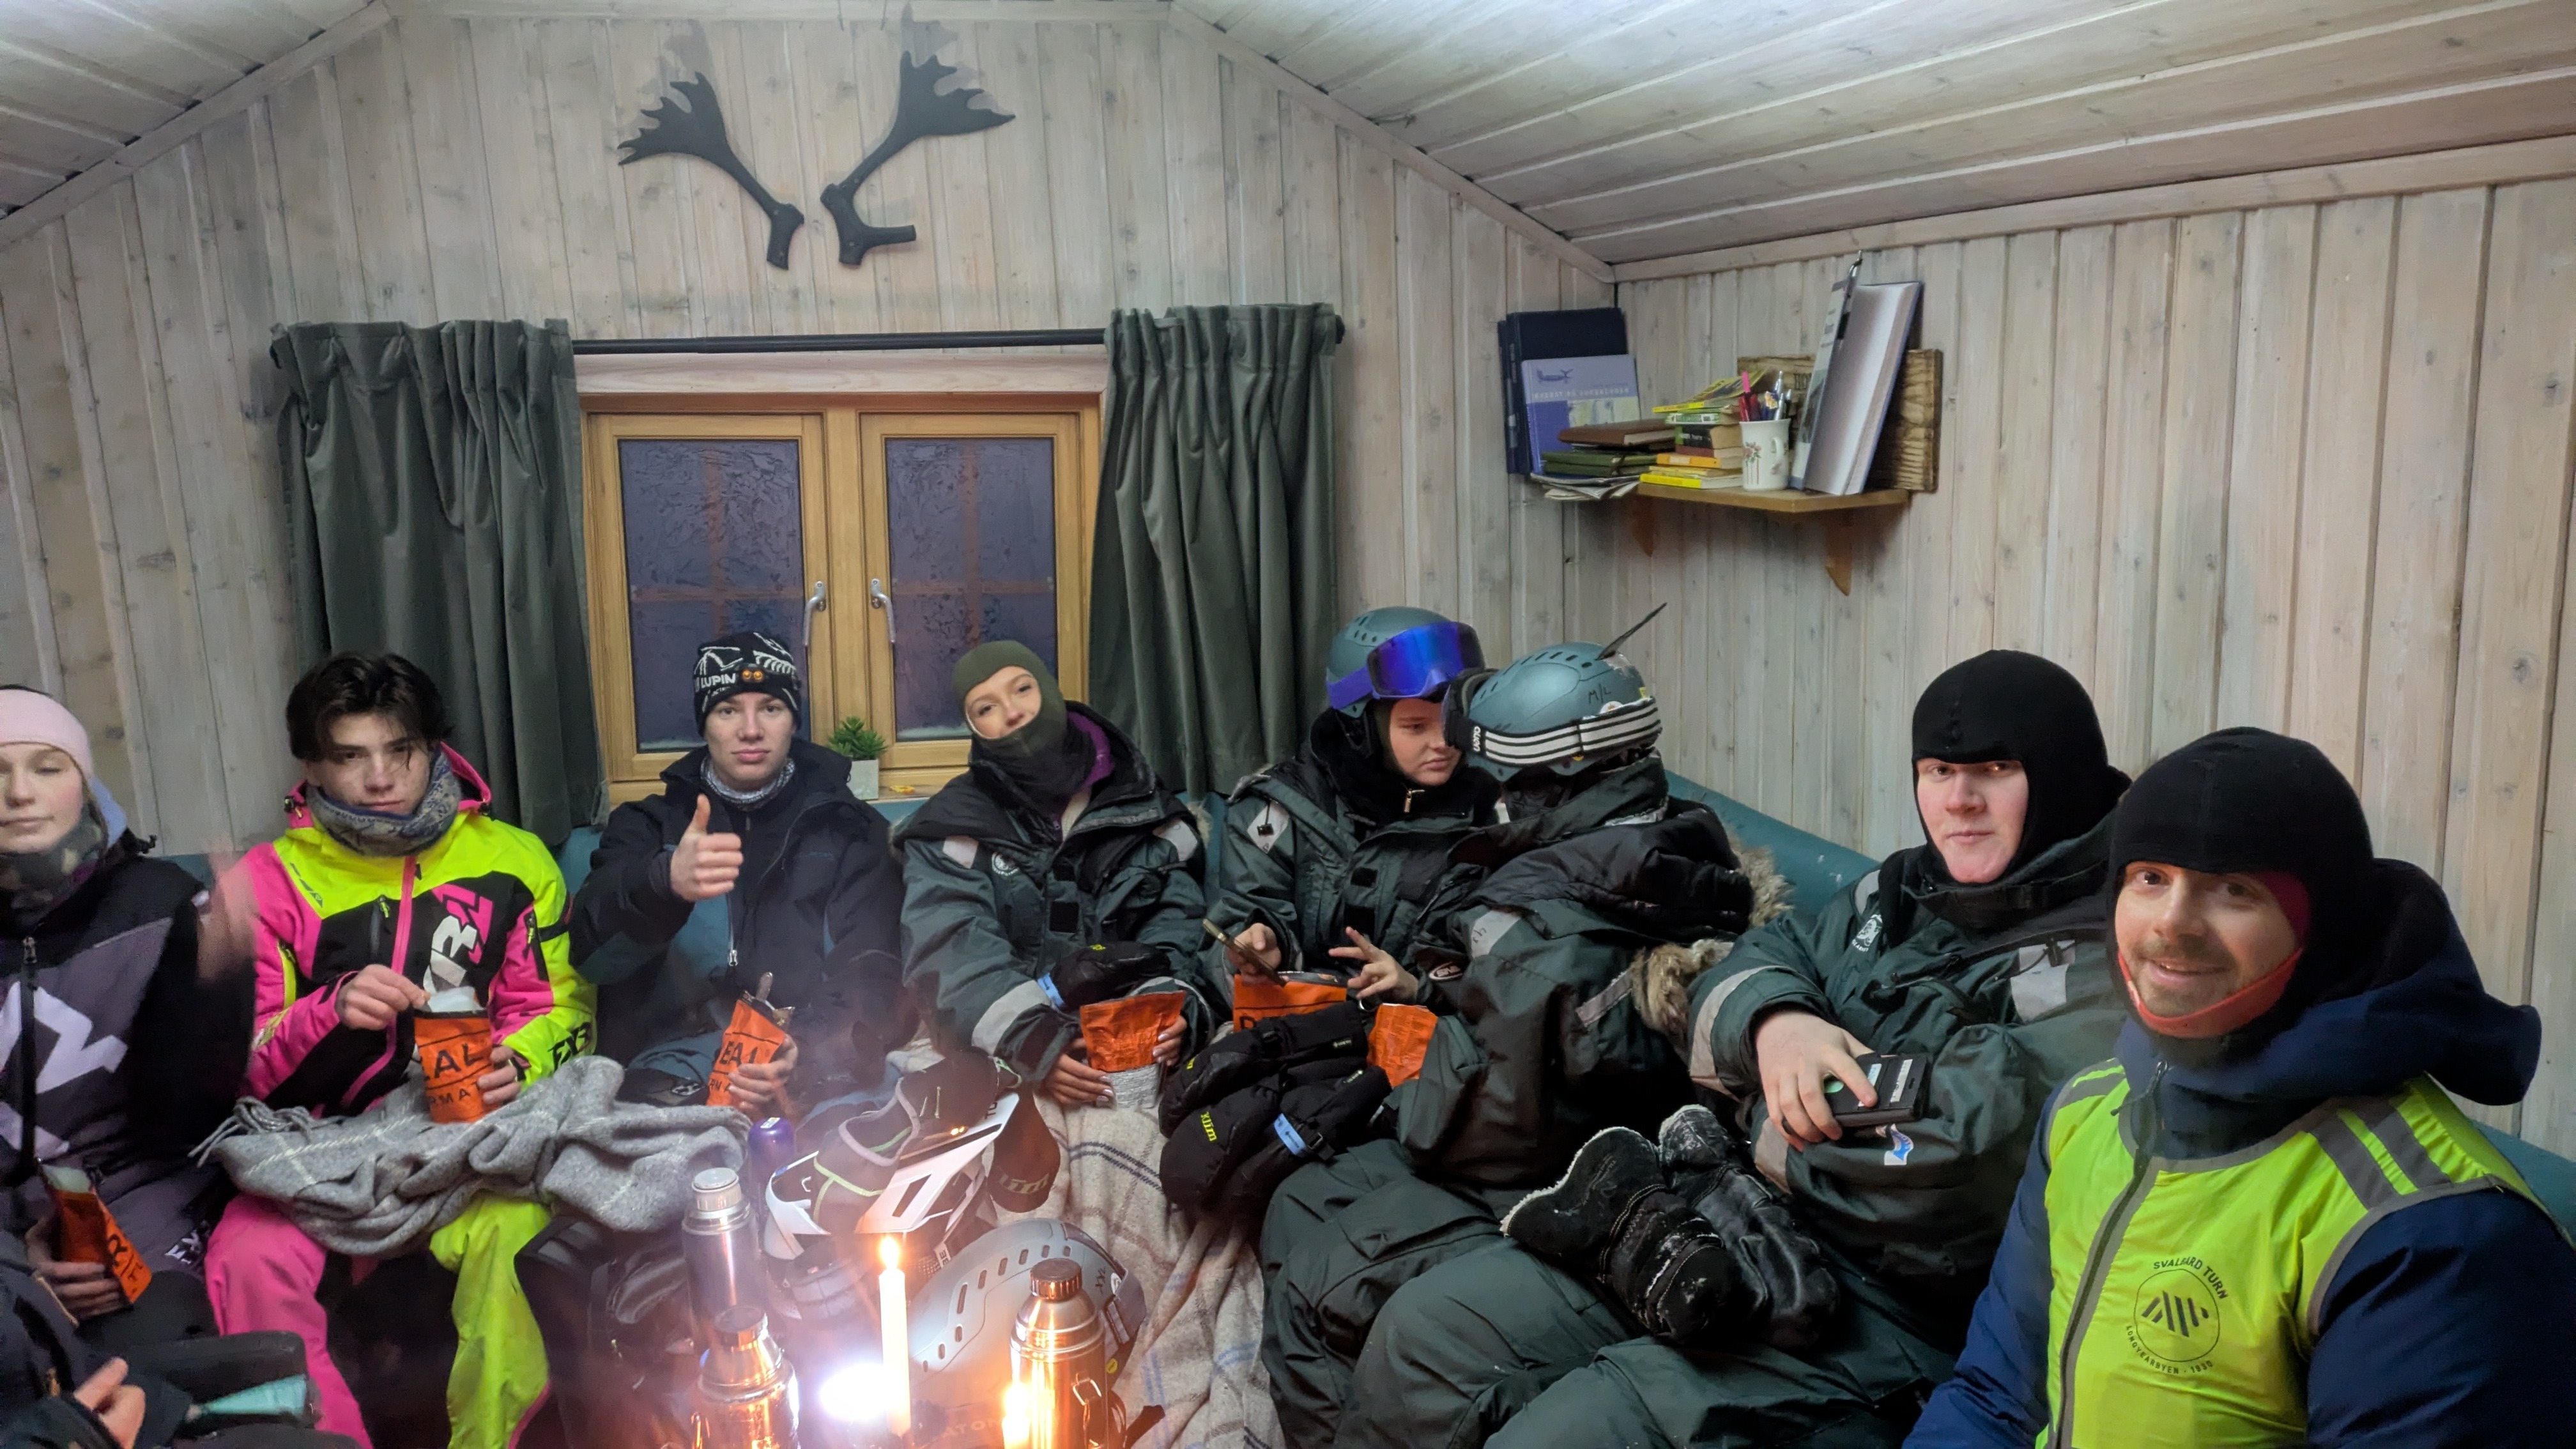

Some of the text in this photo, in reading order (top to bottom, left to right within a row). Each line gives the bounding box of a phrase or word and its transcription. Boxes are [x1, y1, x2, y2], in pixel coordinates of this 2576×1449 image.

[701, 673, 737, 689] LUPIN
[424, 1042, 484, 1081] AL
[2203, 1266, 2228, 1300] TURN
